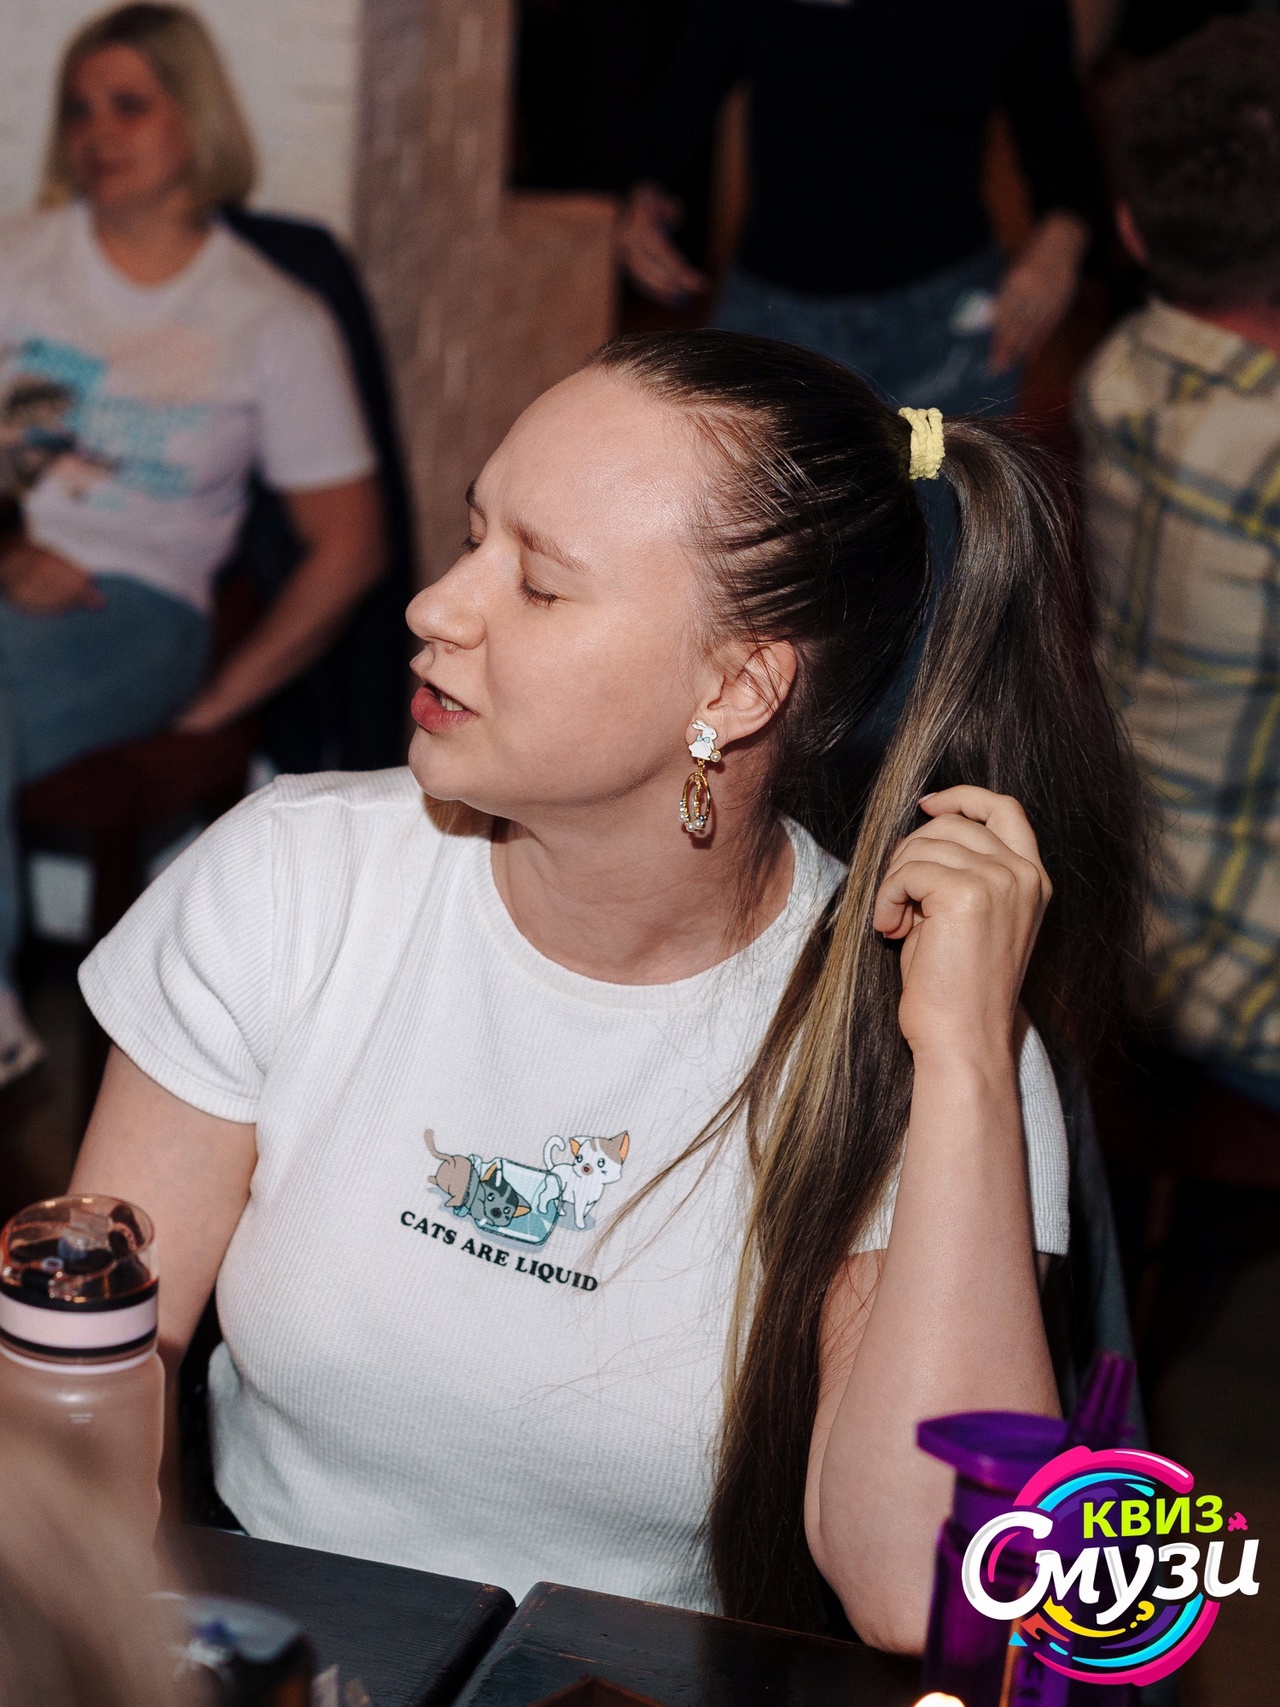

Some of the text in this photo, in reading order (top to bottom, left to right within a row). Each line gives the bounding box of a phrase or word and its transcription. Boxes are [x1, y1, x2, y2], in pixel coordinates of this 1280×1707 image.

[400, 1210, 599, 1293] CATS ARE LIQUID
